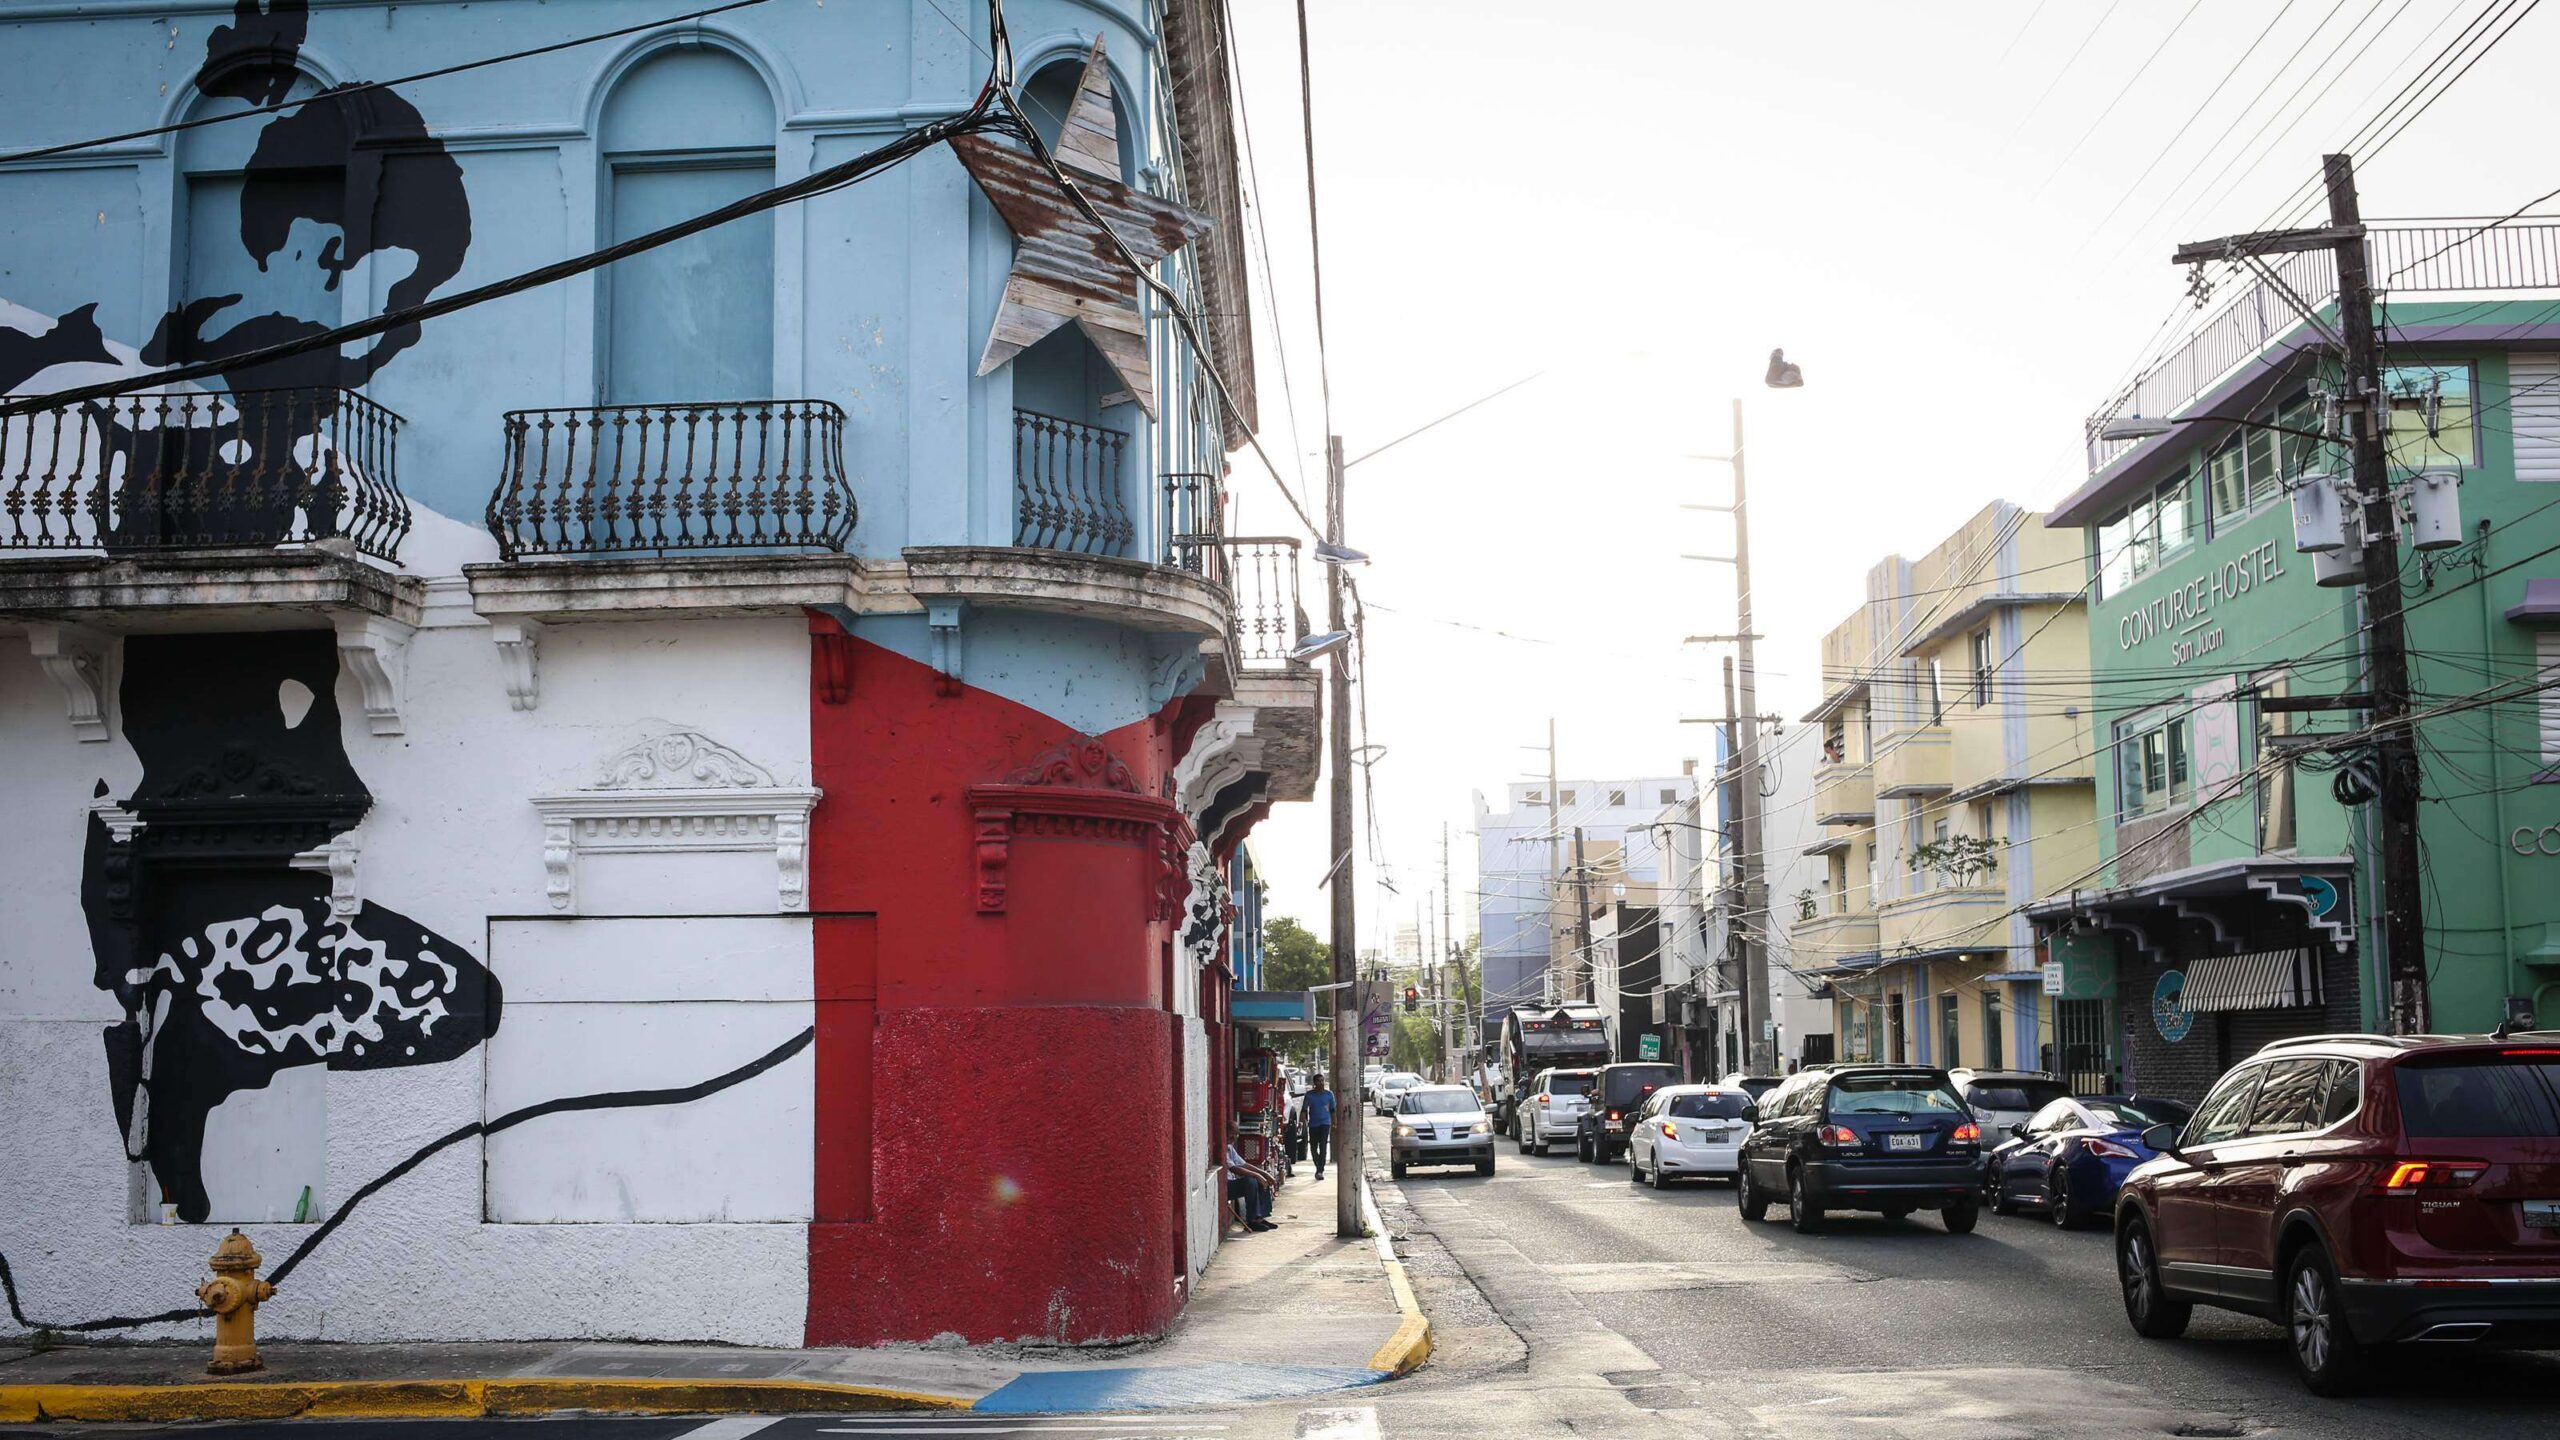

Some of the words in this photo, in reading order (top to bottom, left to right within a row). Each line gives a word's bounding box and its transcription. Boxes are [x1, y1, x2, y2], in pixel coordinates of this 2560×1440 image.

[2119, 575, 2208, 651] CONTURCE
[2210, 538, 2286, 608] HOSTEL
[2172, 640, 2194, 667] San
[2196, 626, 2224, 658] Juan
